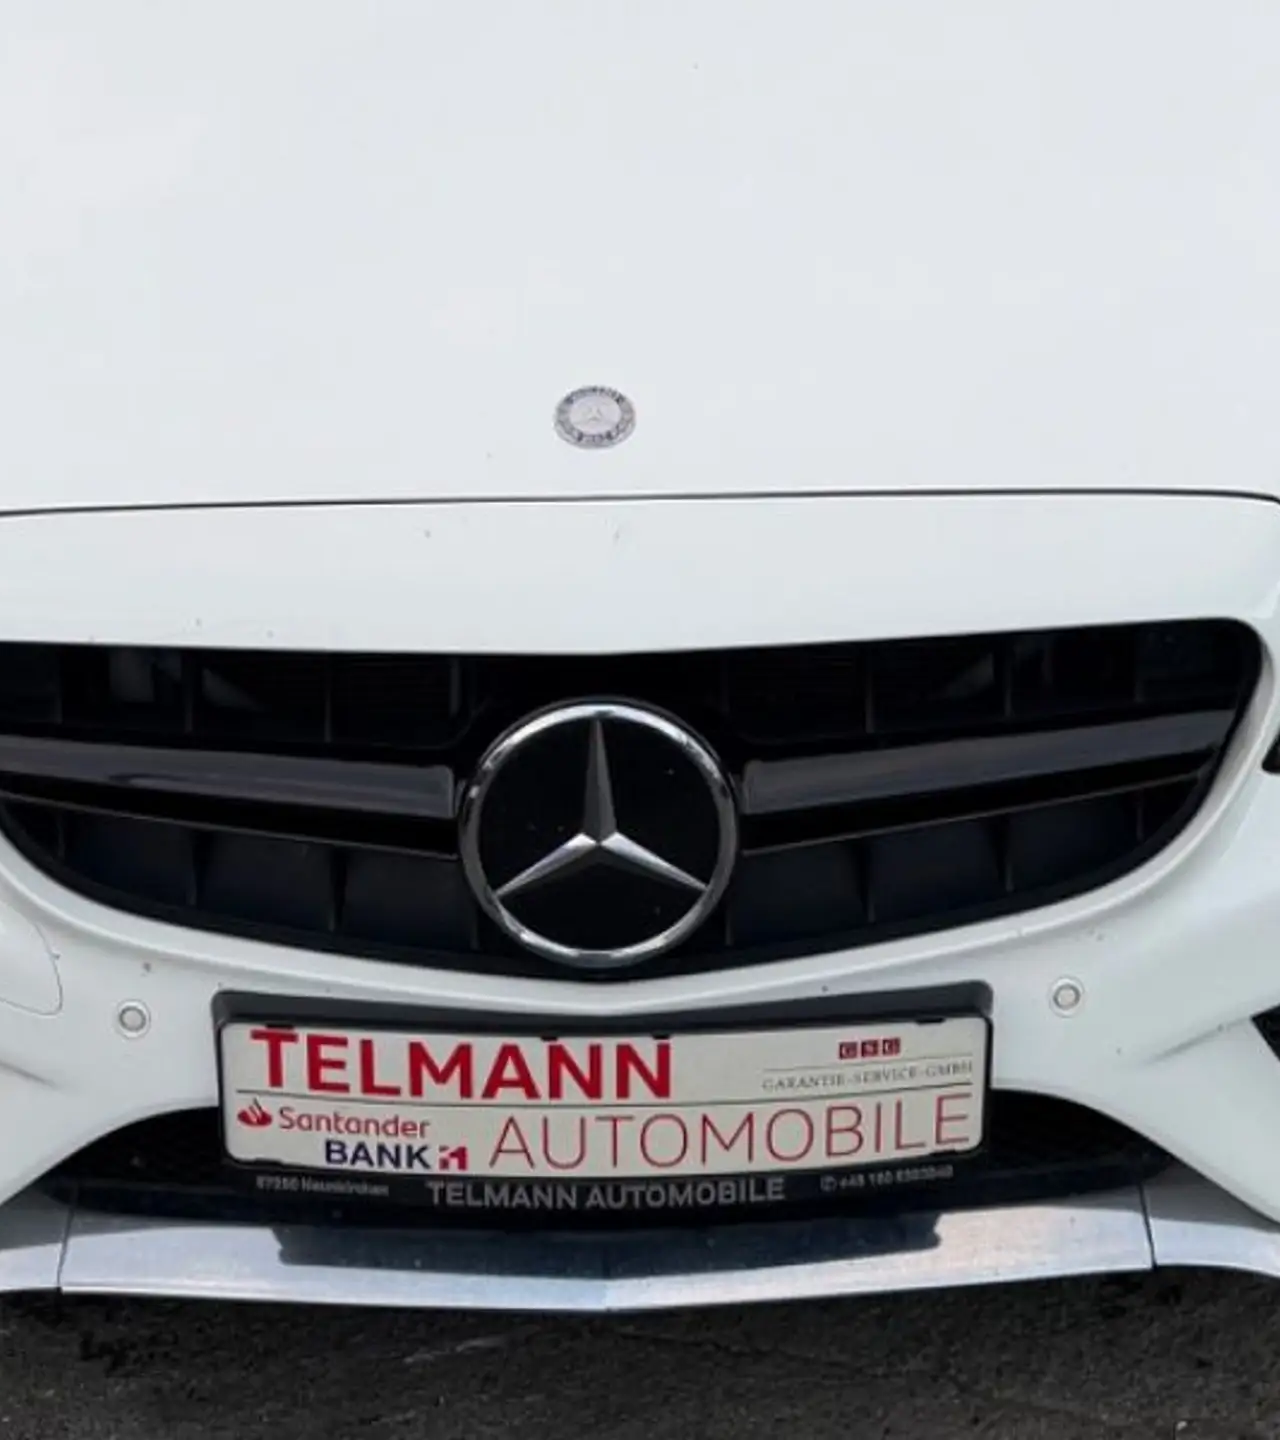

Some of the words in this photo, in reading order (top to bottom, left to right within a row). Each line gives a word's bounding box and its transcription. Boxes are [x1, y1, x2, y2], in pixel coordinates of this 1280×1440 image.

[250, 1029, 671, 1100] TELMANN
[279, 1106, 432, 1139] Santander
[489, 1093, 974, 1170] AUTOMOBILE
[325, 1139, 432, 1170] BANK
[425, 1180, 577, 1210] TELMANN
[584, 1175, 786, 1209] AUTOMOBILE
